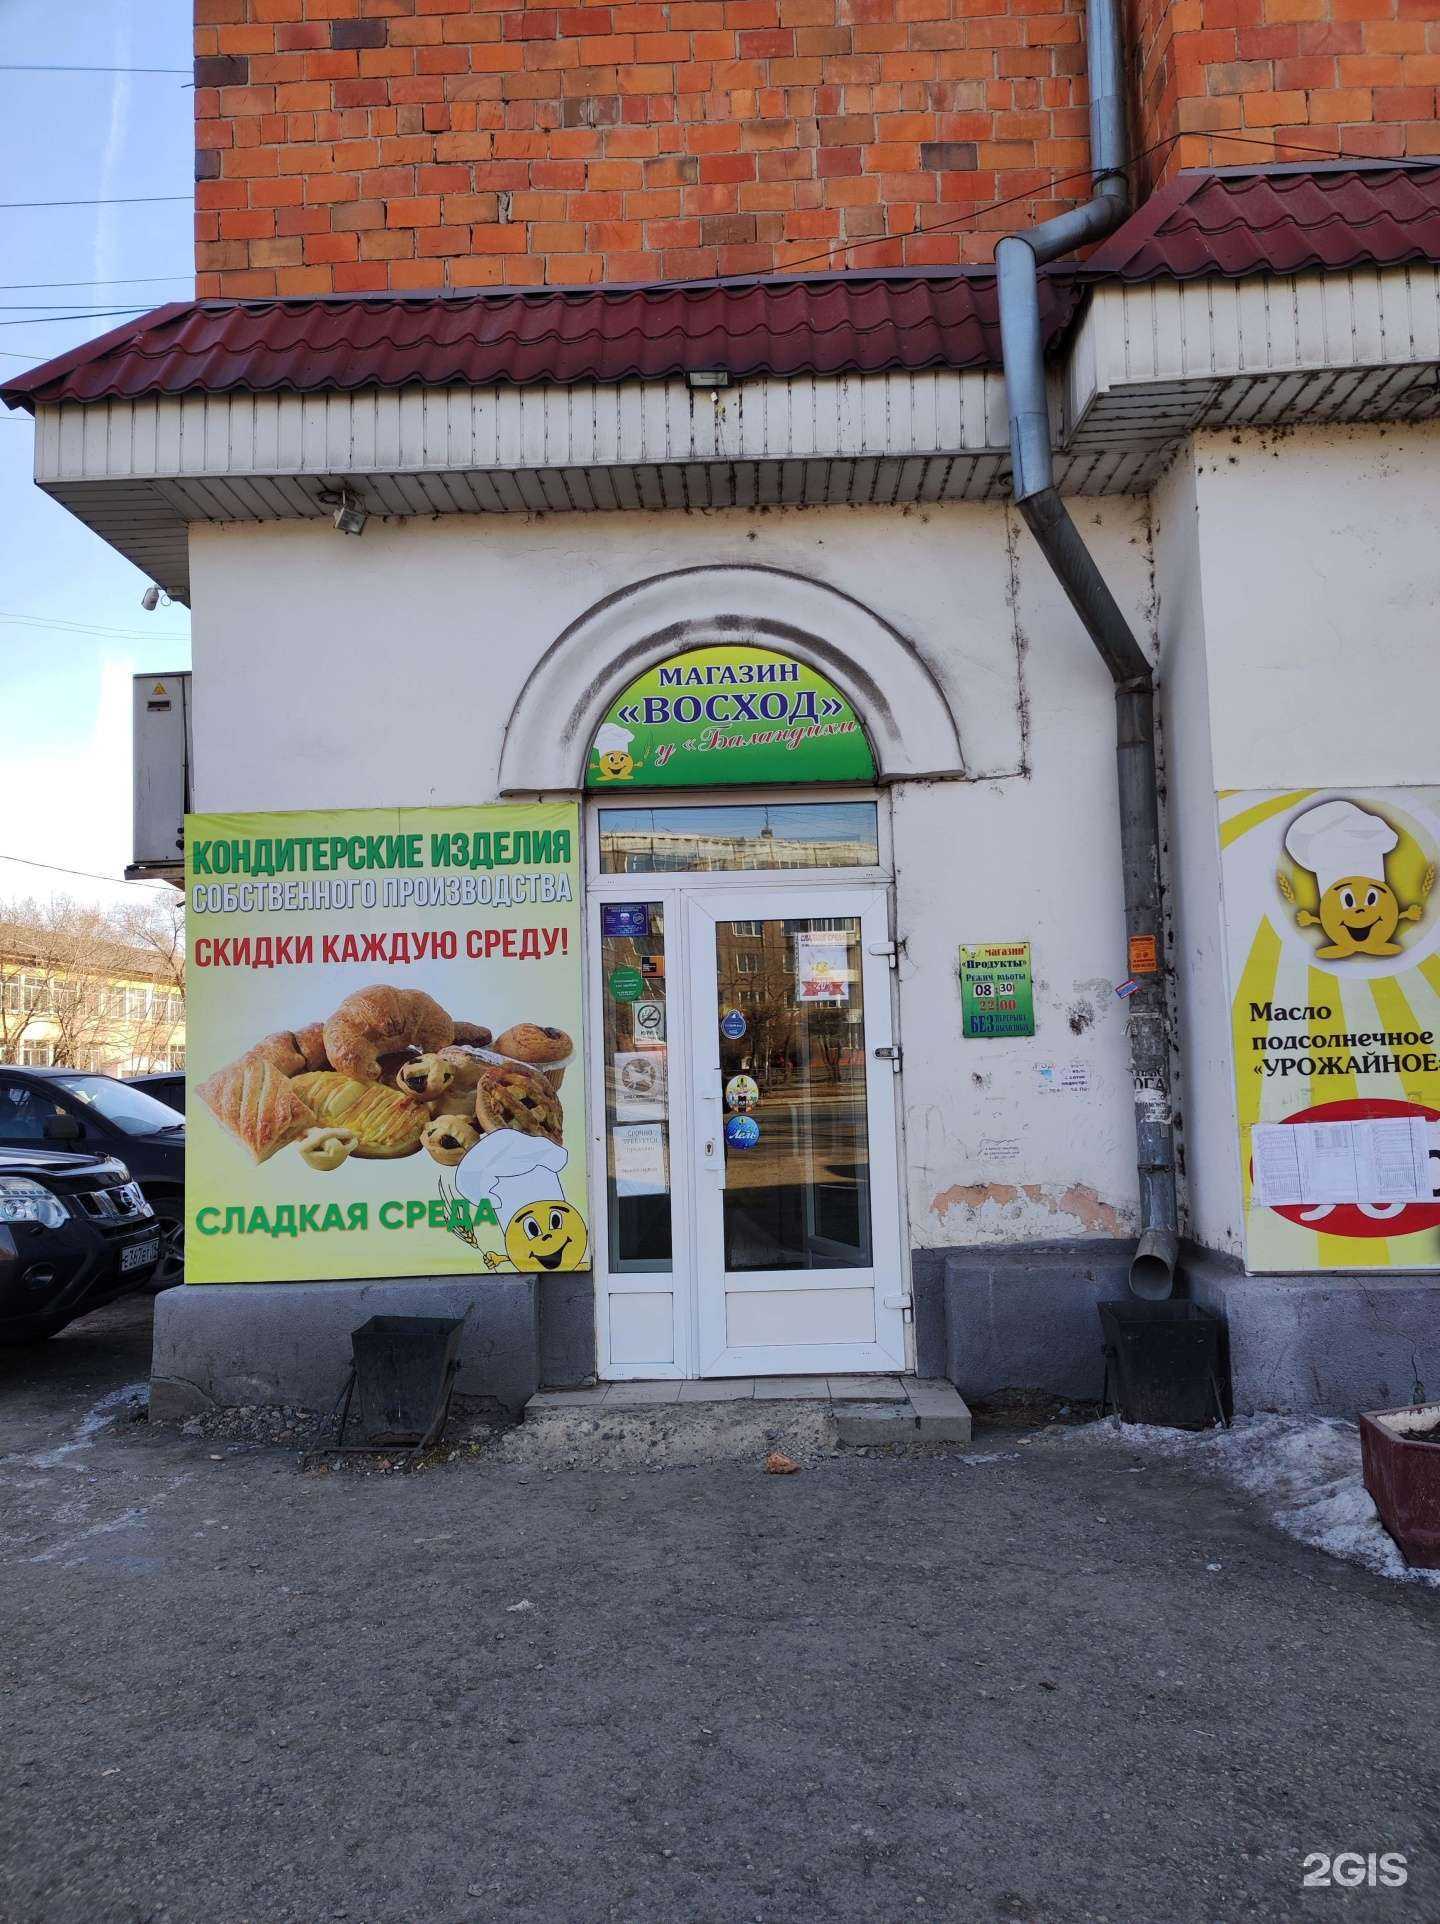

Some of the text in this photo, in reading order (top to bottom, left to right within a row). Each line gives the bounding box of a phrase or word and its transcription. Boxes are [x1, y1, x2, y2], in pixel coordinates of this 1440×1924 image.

[659, 664, 799, 686] МАГАЗИН
[617, 691, 843, 725] «ВОСХОД»
[192, 829, 571, 876] КОНДИТЕРСКИЕ ИЗДЕЛИЯ
[192, 872, 573, 914] СОБСТВЕННОГО ПРОИЗВОДСТВА
[195, 927, 569, 968] СКИДКИ КАЖДУЮ СРЕДУ!
[1249, 1002, 1332, 1021] Масло
[1252, 1031, 1434, 1050] подсолнечное
[1253, 1051, 1440, 1077] «УРОЖАЙНОЕ
[195, 1198, 498, 1237] СЛАДКАЯ СРЕДА
